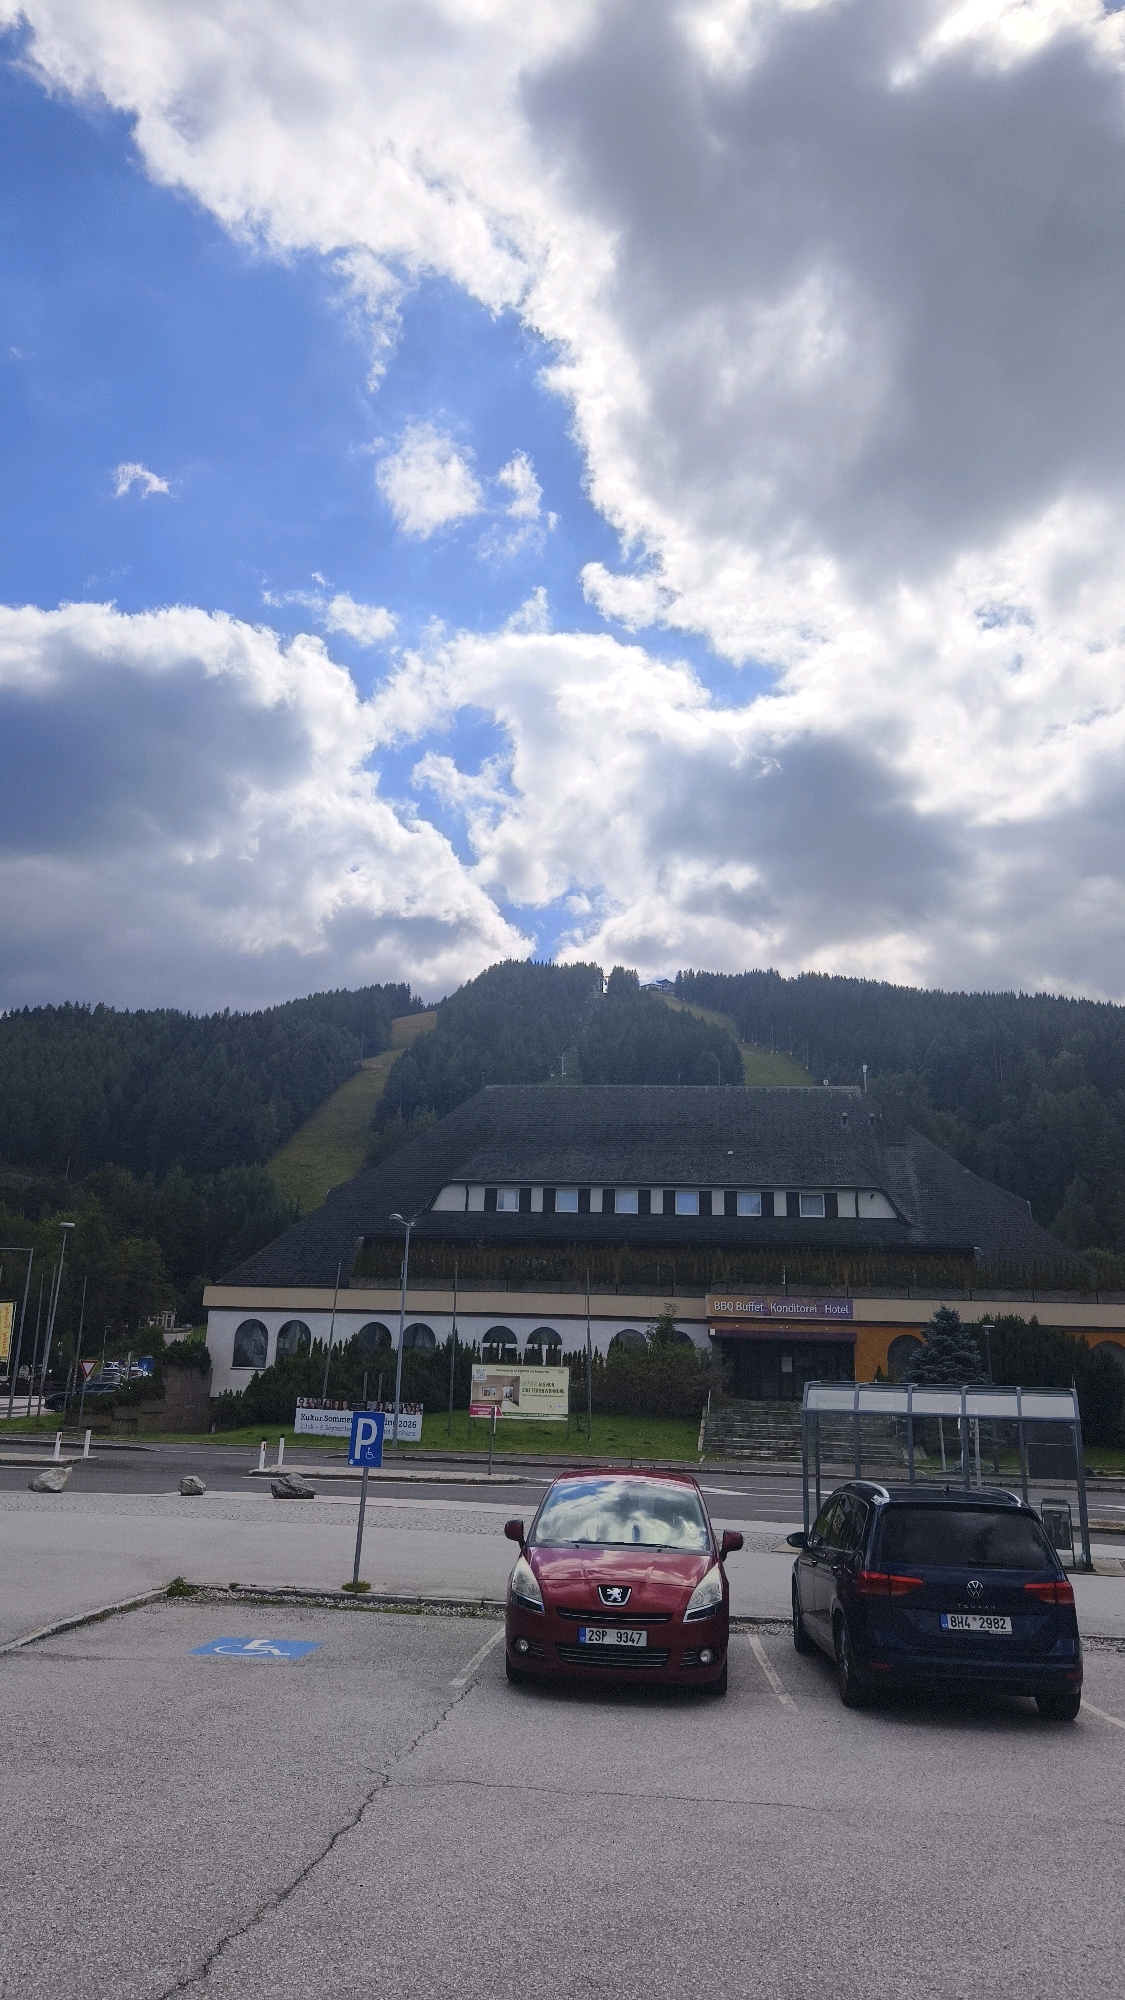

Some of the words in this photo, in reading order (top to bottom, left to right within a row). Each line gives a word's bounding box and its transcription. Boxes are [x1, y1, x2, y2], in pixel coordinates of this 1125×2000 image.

[714, 1301, 734, 1312] BBQ
[736, 1302, 764, 1312] Buffet
[770, 1303, 817, 1313] Konditorei
[825, 1304, 849, 1314] Hotel
[399, 1420, 417, 1429] 2026
[354, 1417, 378, 1460] P
[950, 1616, 971, 1629] 8H4
[979, 1617, 1007, 1630] 2982
[588, 1630, 608, 1642] 2SP
[616, 1631, 643, 1645] 9347
